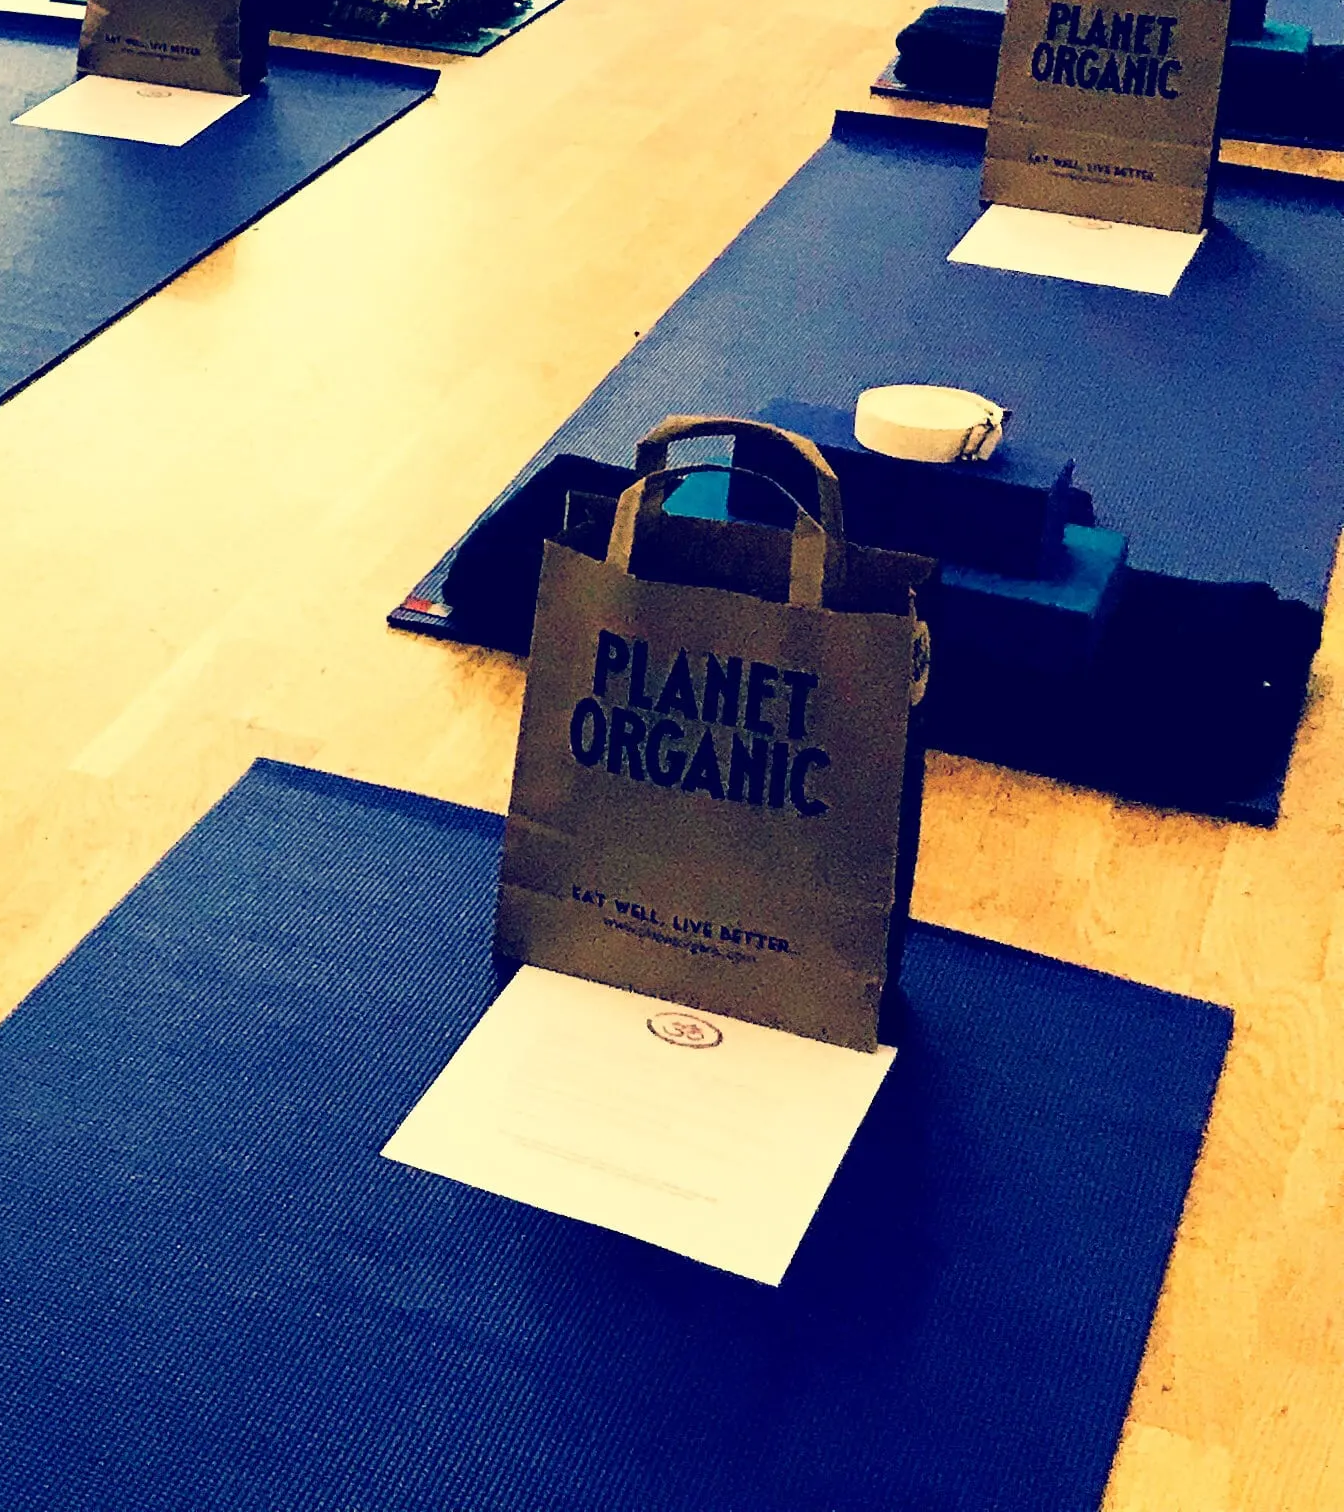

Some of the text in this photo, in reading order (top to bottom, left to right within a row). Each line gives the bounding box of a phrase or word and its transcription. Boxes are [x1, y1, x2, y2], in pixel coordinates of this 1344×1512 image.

[1047, 2, 1178, 57] PLANET
[1031, 41, 1183, 100] ORGANIC
[593, 629, 819, 739] PLANET
[570, 697, 831, 817] ORGANIC
[572, 883, 606, 909] EAT
[672, 915, 714, 938] LIVE
